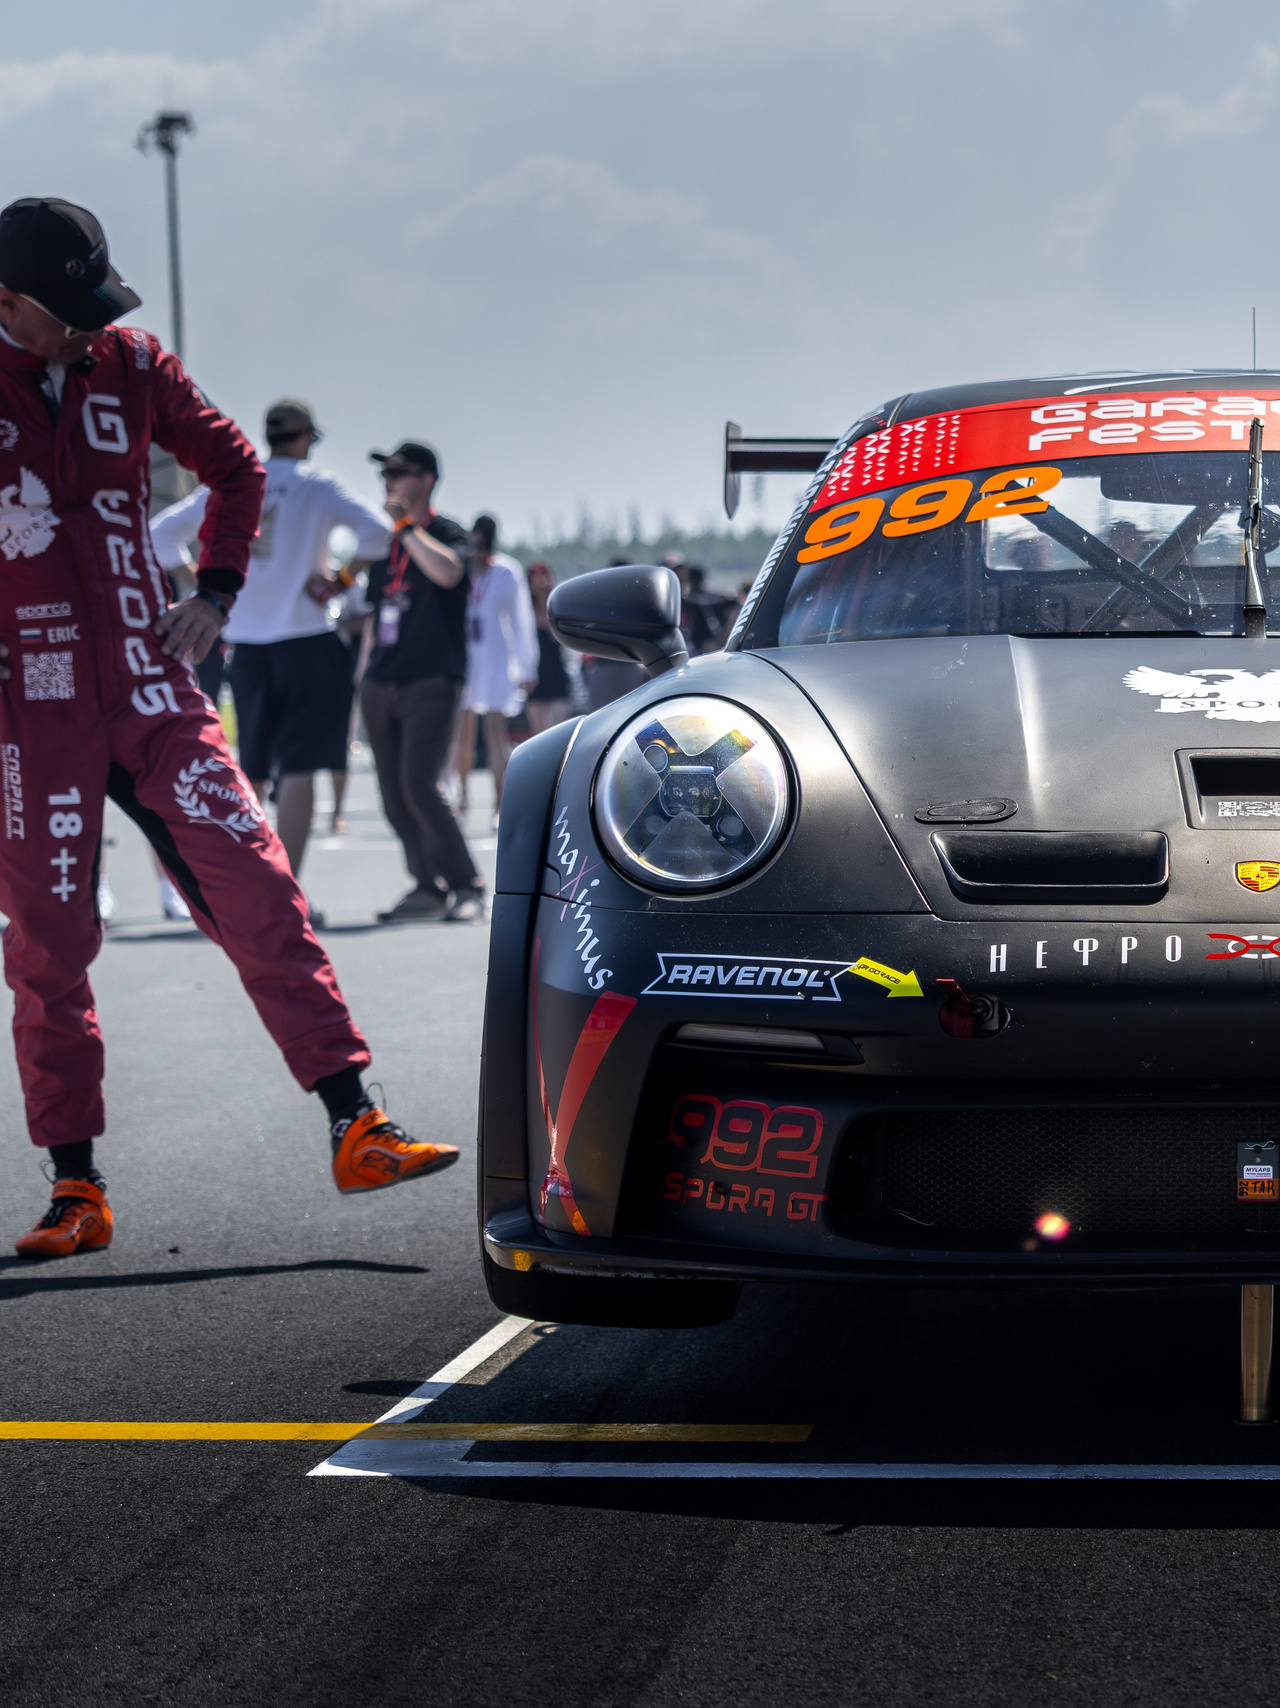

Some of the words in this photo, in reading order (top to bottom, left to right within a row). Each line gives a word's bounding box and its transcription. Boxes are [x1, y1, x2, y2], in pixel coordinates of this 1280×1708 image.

[5, 512, 51, 553] SPORA
[796, 466, 1063, 564] 992
[15, 601, 73, 621] sparco
[47, 623, 81, 644] ERIC
[989, 934, 1183, 973] НЕФРО
[664, 1094, 824, 1175] 992
[663, 1172, 775, 1217] SPORA
[787, 1191, 829, 1222] GT
[1251, 1180, 1276, 1197] TAR
